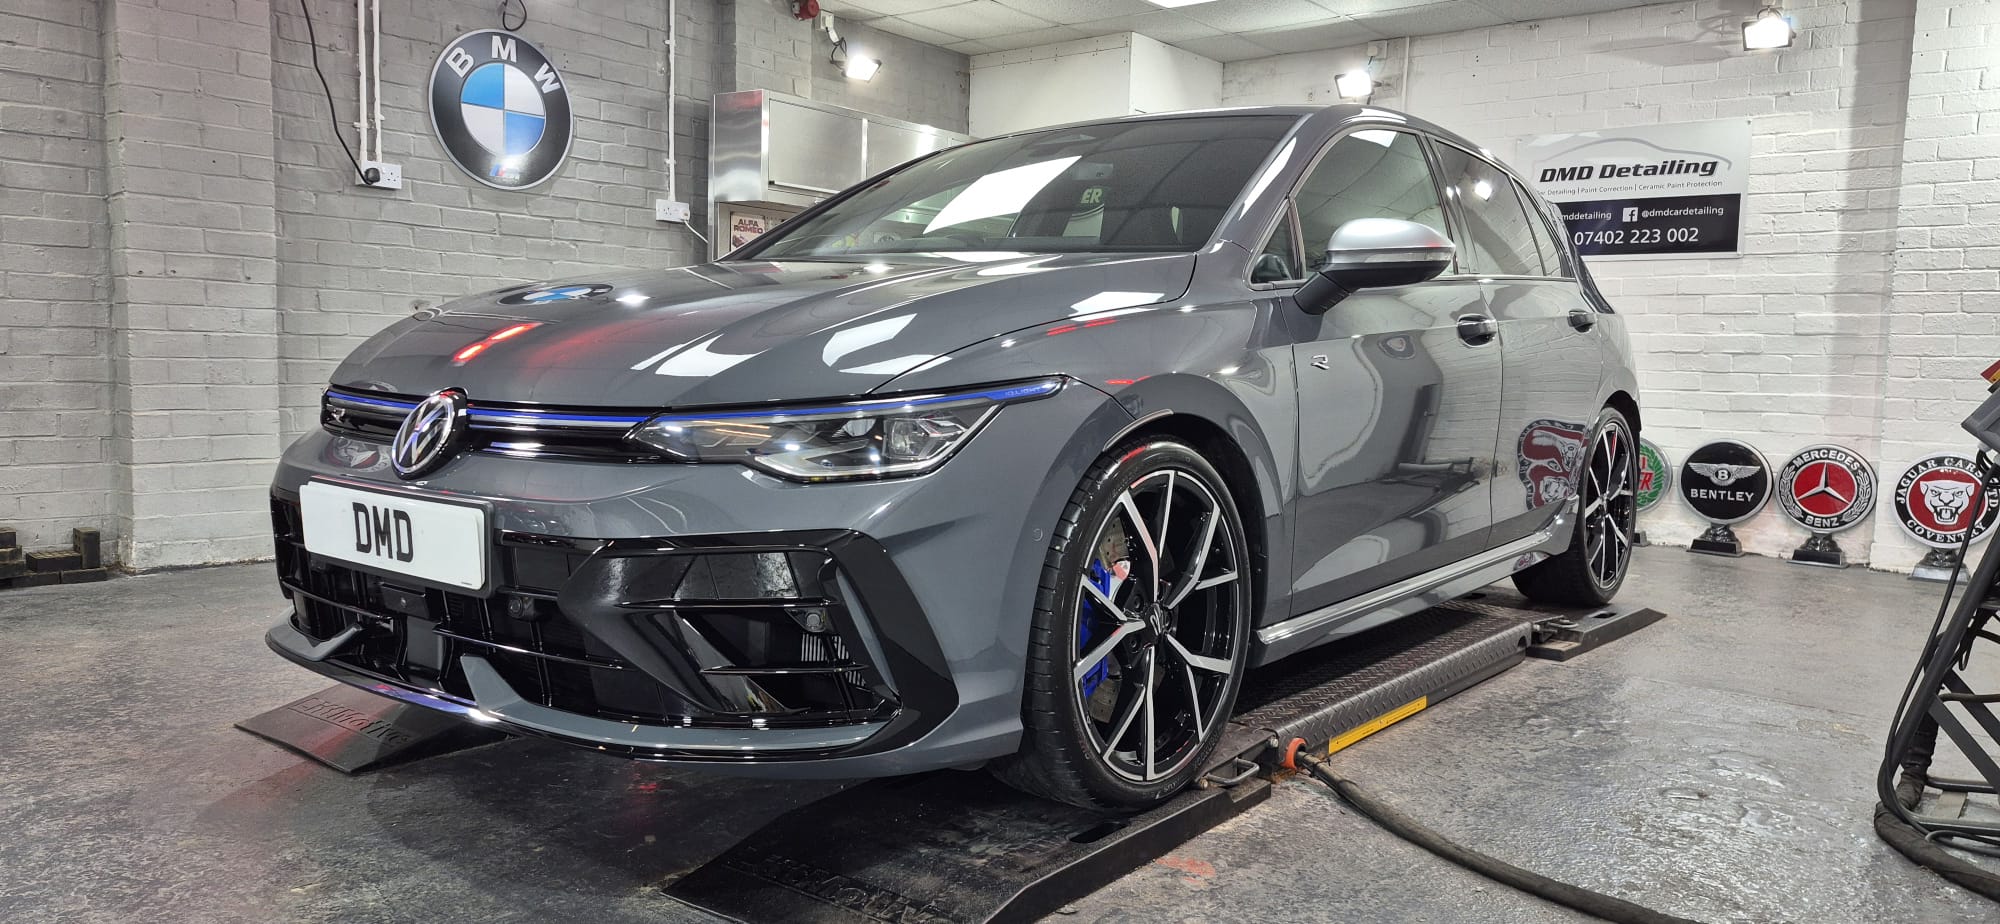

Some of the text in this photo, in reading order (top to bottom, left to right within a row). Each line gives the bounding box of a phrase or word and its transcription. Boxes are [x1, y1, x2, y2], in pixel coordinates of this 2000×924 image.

[446, 35, 561, 94] BMW
[1539, 160, 1719, 183] DMD Detailing
[1600, 185, 1633, 193] Correction
[1639, 183, 1665, 191] Ceramic
[1686, 180, 1723, 189] Protection
[1562, 211, 1612, 221] mddetailing
[1641, 206, 1724, 219] @dmdcardetailing
[733, 225, 764, 234] ROMEO
[738, 218, 759, 227] ALFA
[1574, 227, 1699, 246] 07402 223 002
[1794, 449, 1862, 472] MERCEDES
[1896, 459, 1938, 504] JAGUAR
[1943, 458, 1984, 479] CARS
[1690, 488, 1755, 503] BENTLEY
[1805, 515, 1840, 528] BENZ
[352, 501, 415, 563] DMD
